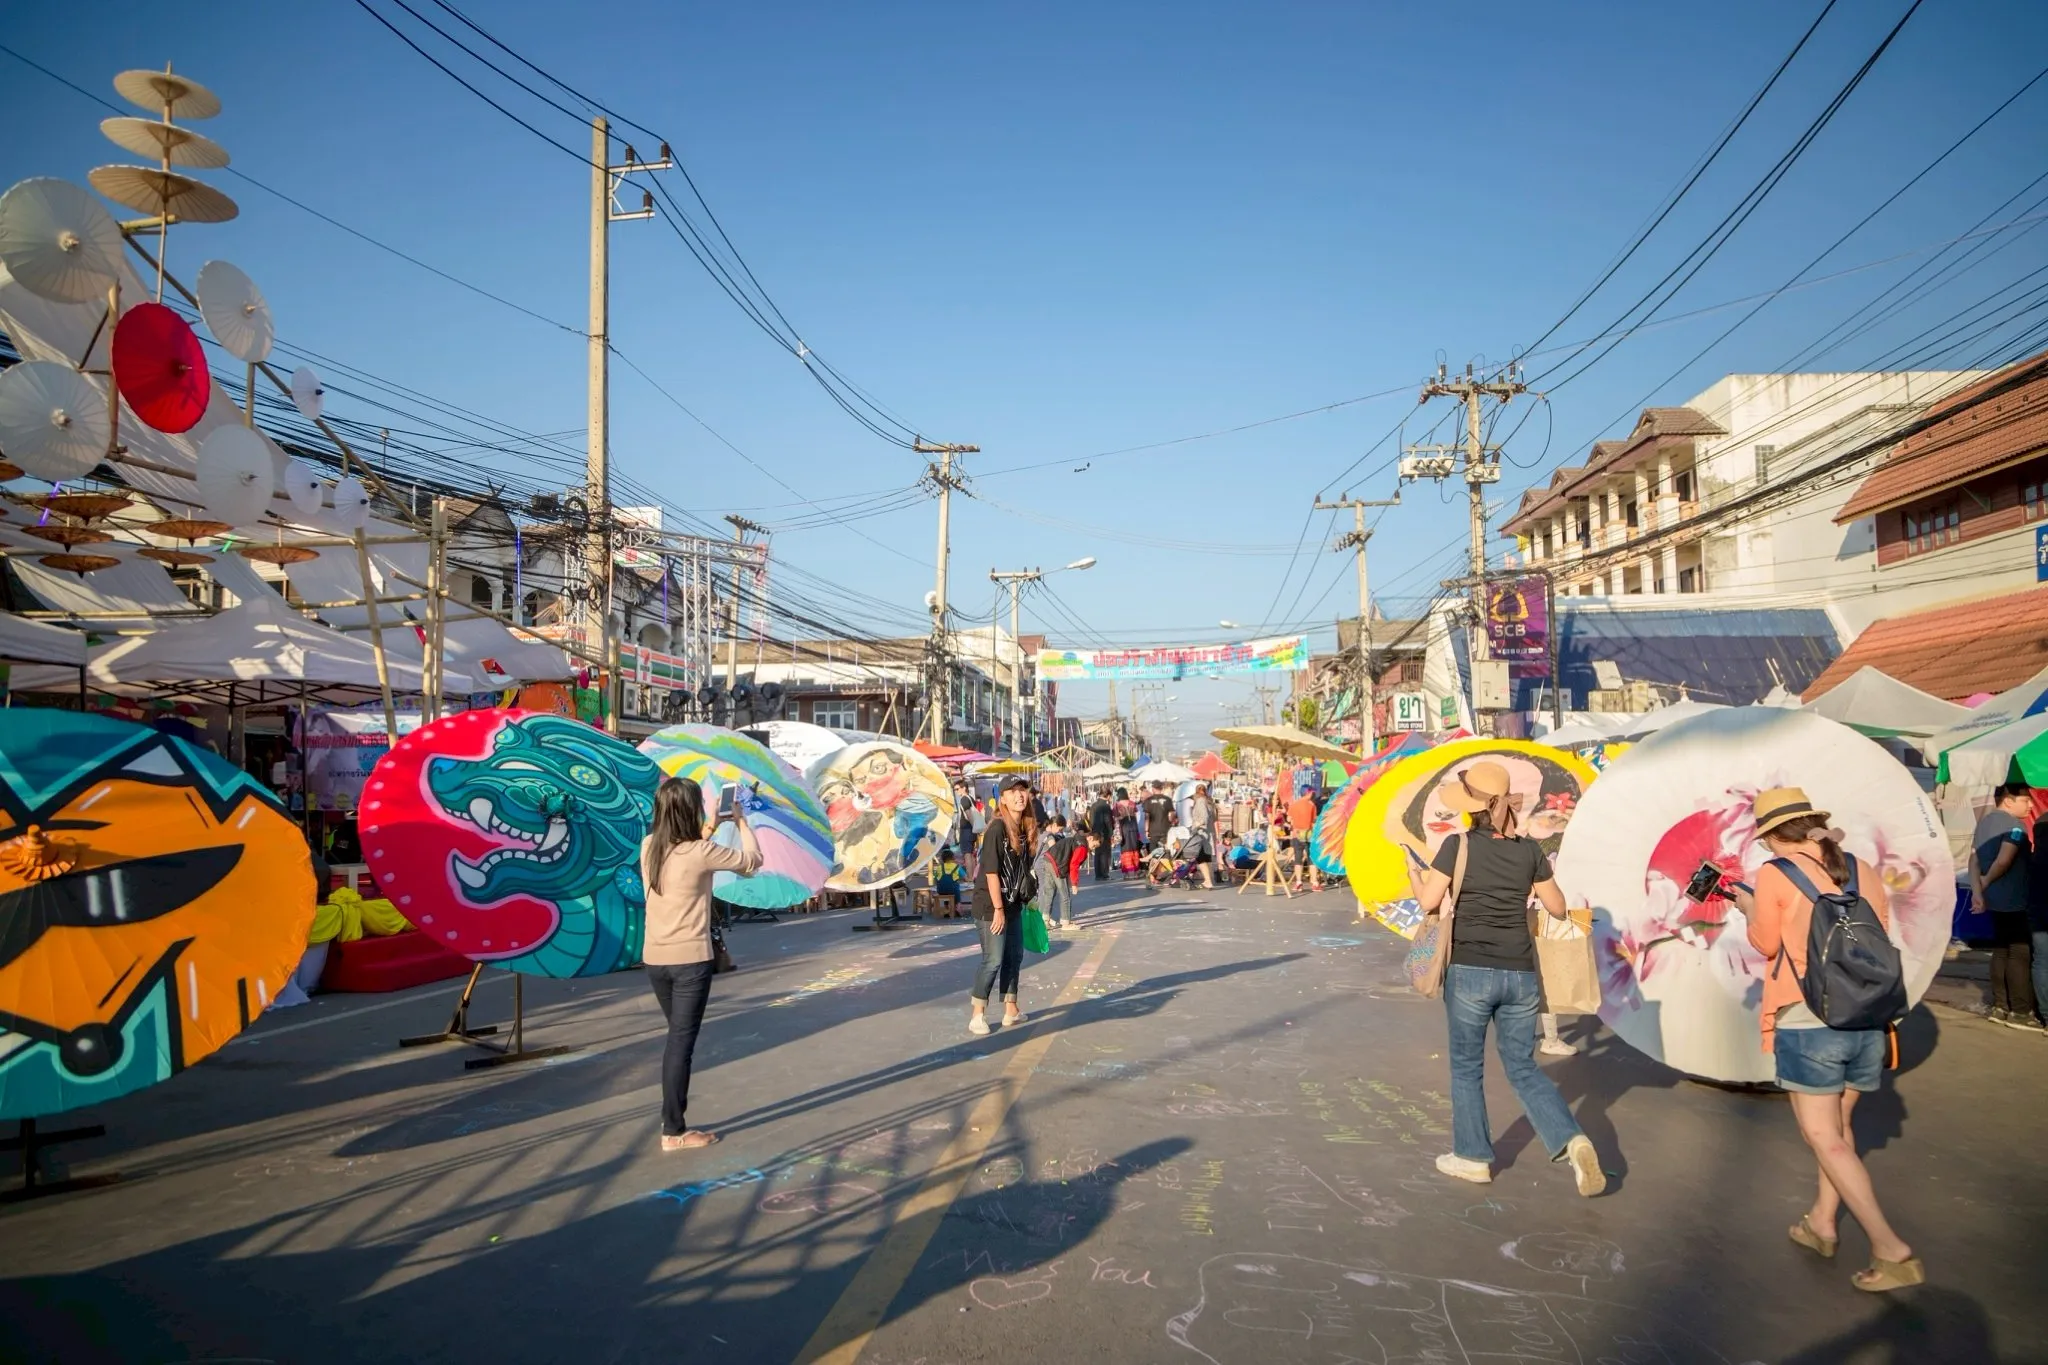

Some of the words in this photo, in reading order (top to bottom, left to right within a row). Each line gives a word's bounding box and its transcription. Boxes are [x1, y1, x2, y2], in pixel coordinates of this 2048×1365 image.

[1494, 624, 1526, 637] SCB
[1399, 696, 1422, 719] ยา
[1088, 1255, 1158, 1289] You
